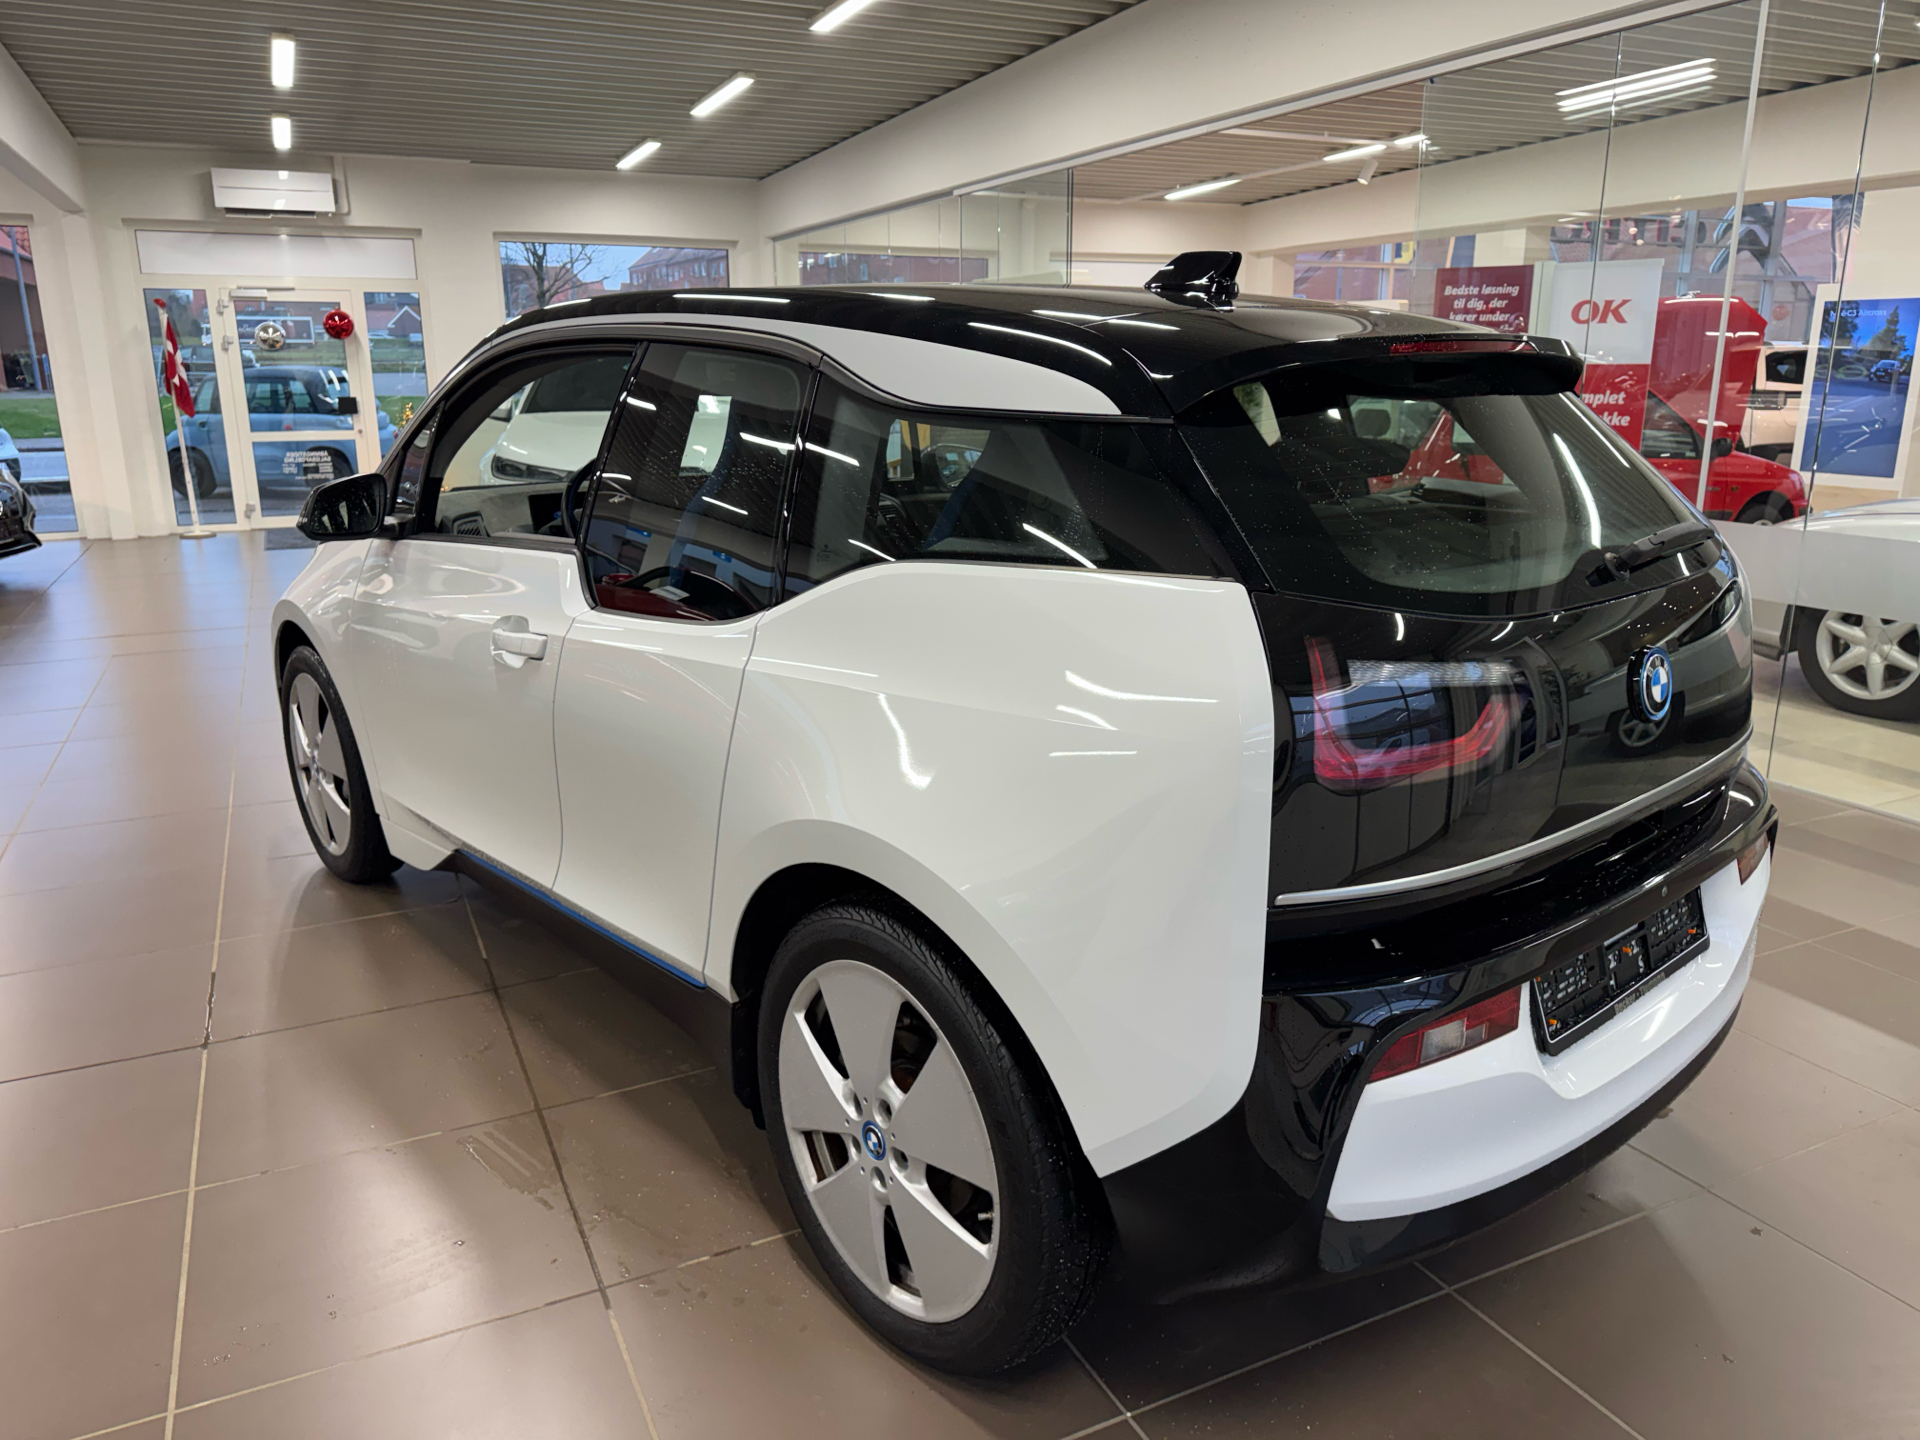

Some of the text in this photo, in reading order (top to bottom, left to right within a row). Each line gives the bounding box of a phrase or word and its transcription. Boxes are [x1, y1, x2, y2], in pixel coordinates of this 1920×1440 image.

[1444, 283, 1520, 297] Bedste løsning
[1453, 297, 1508, 311] til dig, der
[1449, 311, 1511, 322] kører under
[1571, 299, 1633, 325] OK
[1858, 308, 1887, 317] Aircross
[1582, 390, 1626, 407] mplet
[1602, 411, 1631, 427] kke
[1647, 656, 1669, 677] BMW
